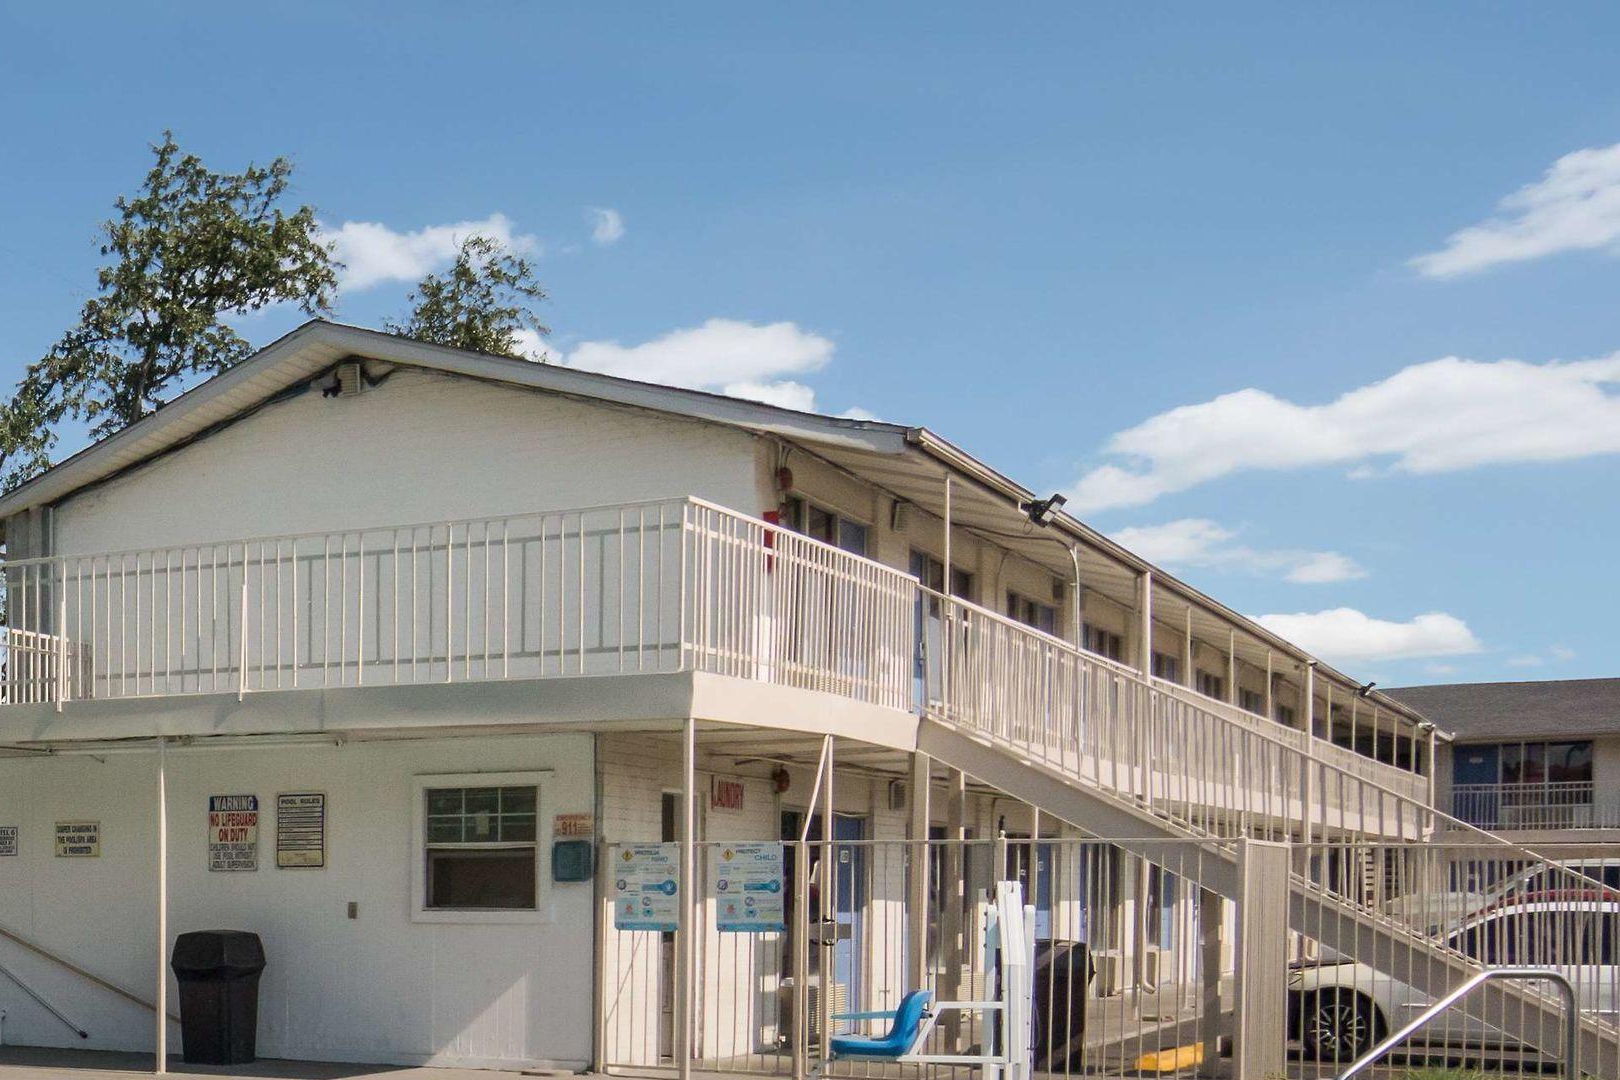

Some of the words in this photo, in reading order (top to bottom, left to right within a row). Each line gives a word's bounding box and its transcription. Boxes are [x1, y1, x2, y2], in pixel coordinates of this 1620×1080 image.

[214, 796, 254, 811] WARNING
[210, 812, 220, 827] NO
[221, 812, 257, 827] LIFEGUARD
[218, 828, 229, 842] ON
[230, 827, 249, 842] DUTY
[561, 821, 578, 835] 911
